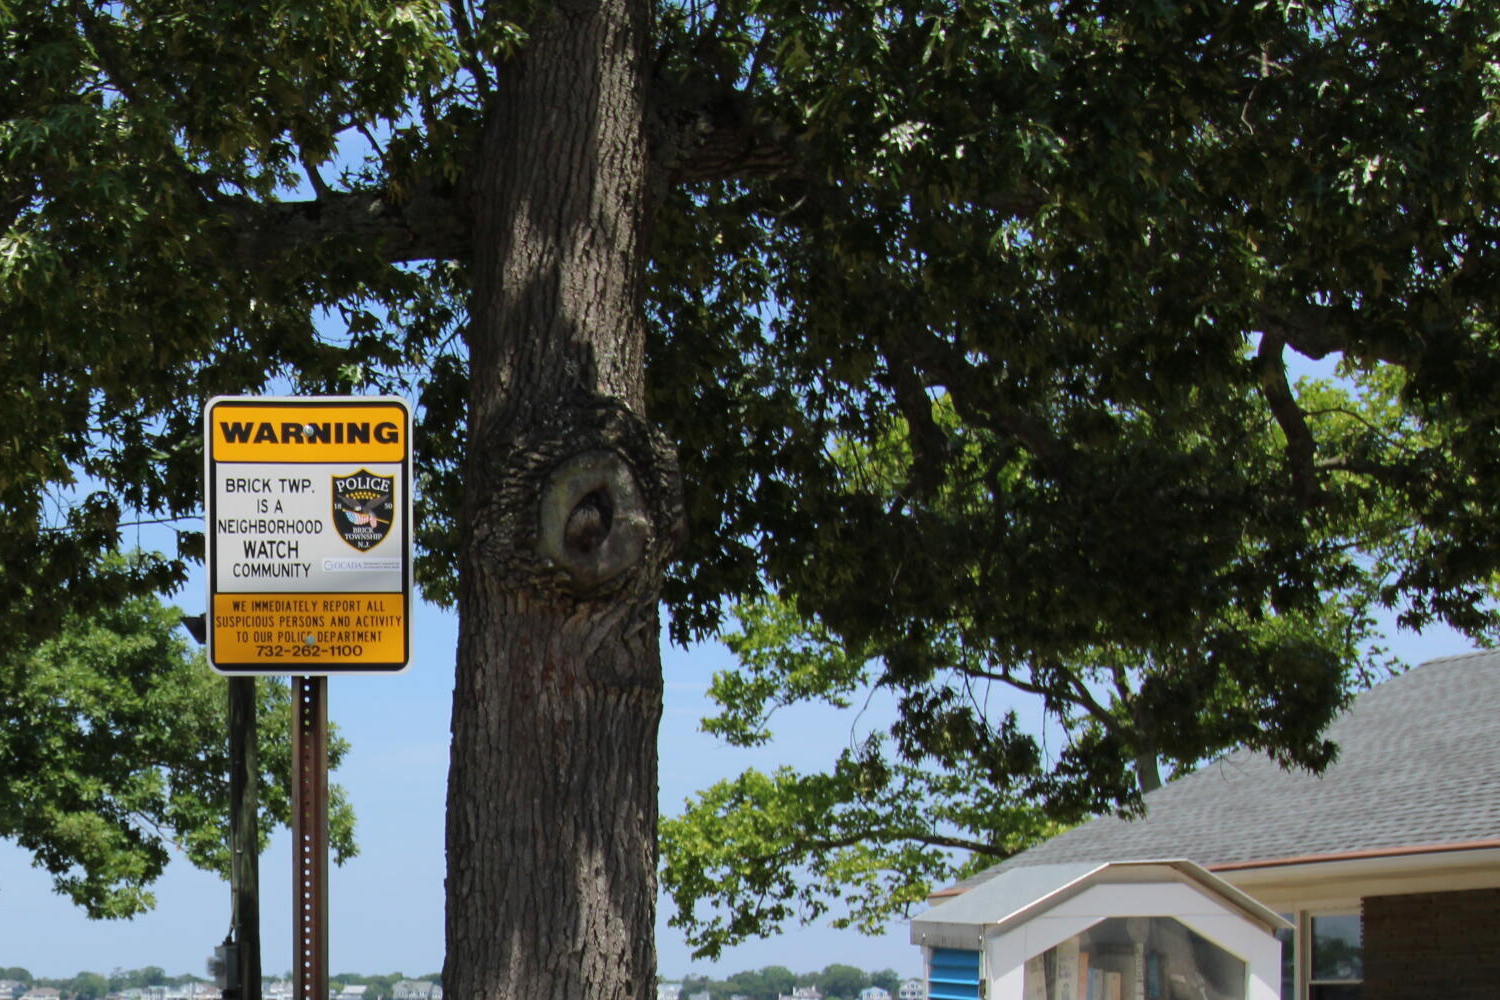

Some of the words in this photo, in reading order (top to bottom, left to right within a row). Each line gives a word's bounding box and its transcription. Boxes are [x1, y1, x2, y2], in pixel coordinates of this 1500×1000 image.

[219, 421, 399, 444] WARNING
[225, 478, 272, 493] BRICK
[278, 478, 315, 493] TWP.
[335, 477, 391, 493] POLICE
[257, 499, 269, 513] IS
[274, 499, 284, 513] A
[218, 519, 323, 534] NEIGHBORHOOD
[345, 533, 382, 541] TOWNSHIP
[243, 540, 299, 559] WATCH
[232, 563, 311, 578] COMMUNITY
[232, 600, 247, 612] WE
[251, 600, 318, 612] IMMEDIATELY
[323, 600, 361, 612] REPORT
[366, 600, 385, 612] ALL
[216, 616, 275, 628] SUSPICIOUS
[279, 616, 325, 628] PERSONS
[330, 616, 351, 628] AND
[355, 616, 401, 628] ACTIVITY
[236, 631, 249, 643] TO
[253, 631, 273, 643] OUR
[317, 631, 382, 643] DEPARTMENT
[256, 645, 363, 657] 732-262-1100
